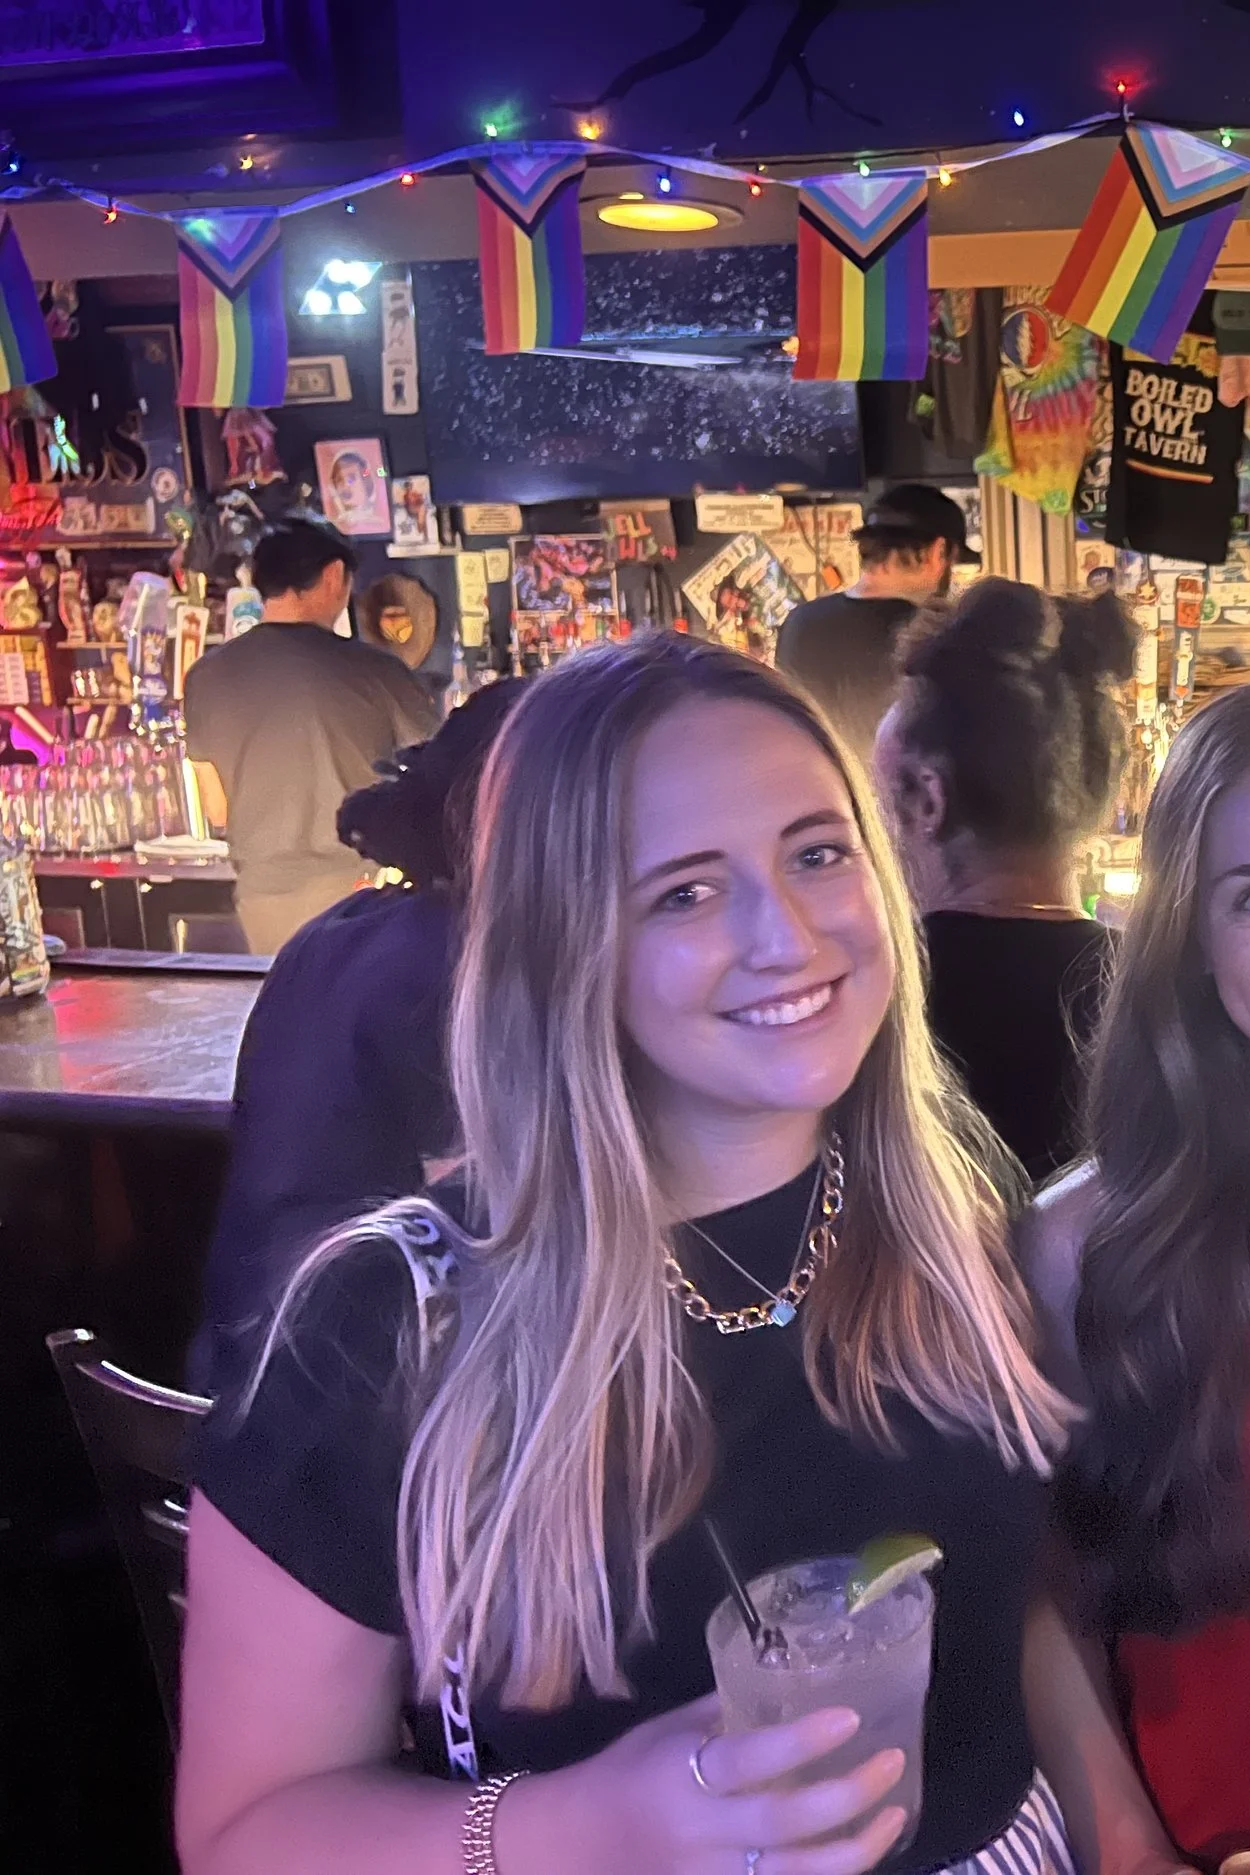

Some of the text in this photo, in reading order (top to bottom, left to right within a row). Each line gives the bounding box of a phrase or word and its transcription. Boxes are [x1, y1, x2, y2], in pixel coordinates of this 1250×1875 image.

[1125, 369, 1213, 414] BOILED
[1130, 398, 1199, 441] OWL
[1124, 427, 1208, 465] TAVERN
